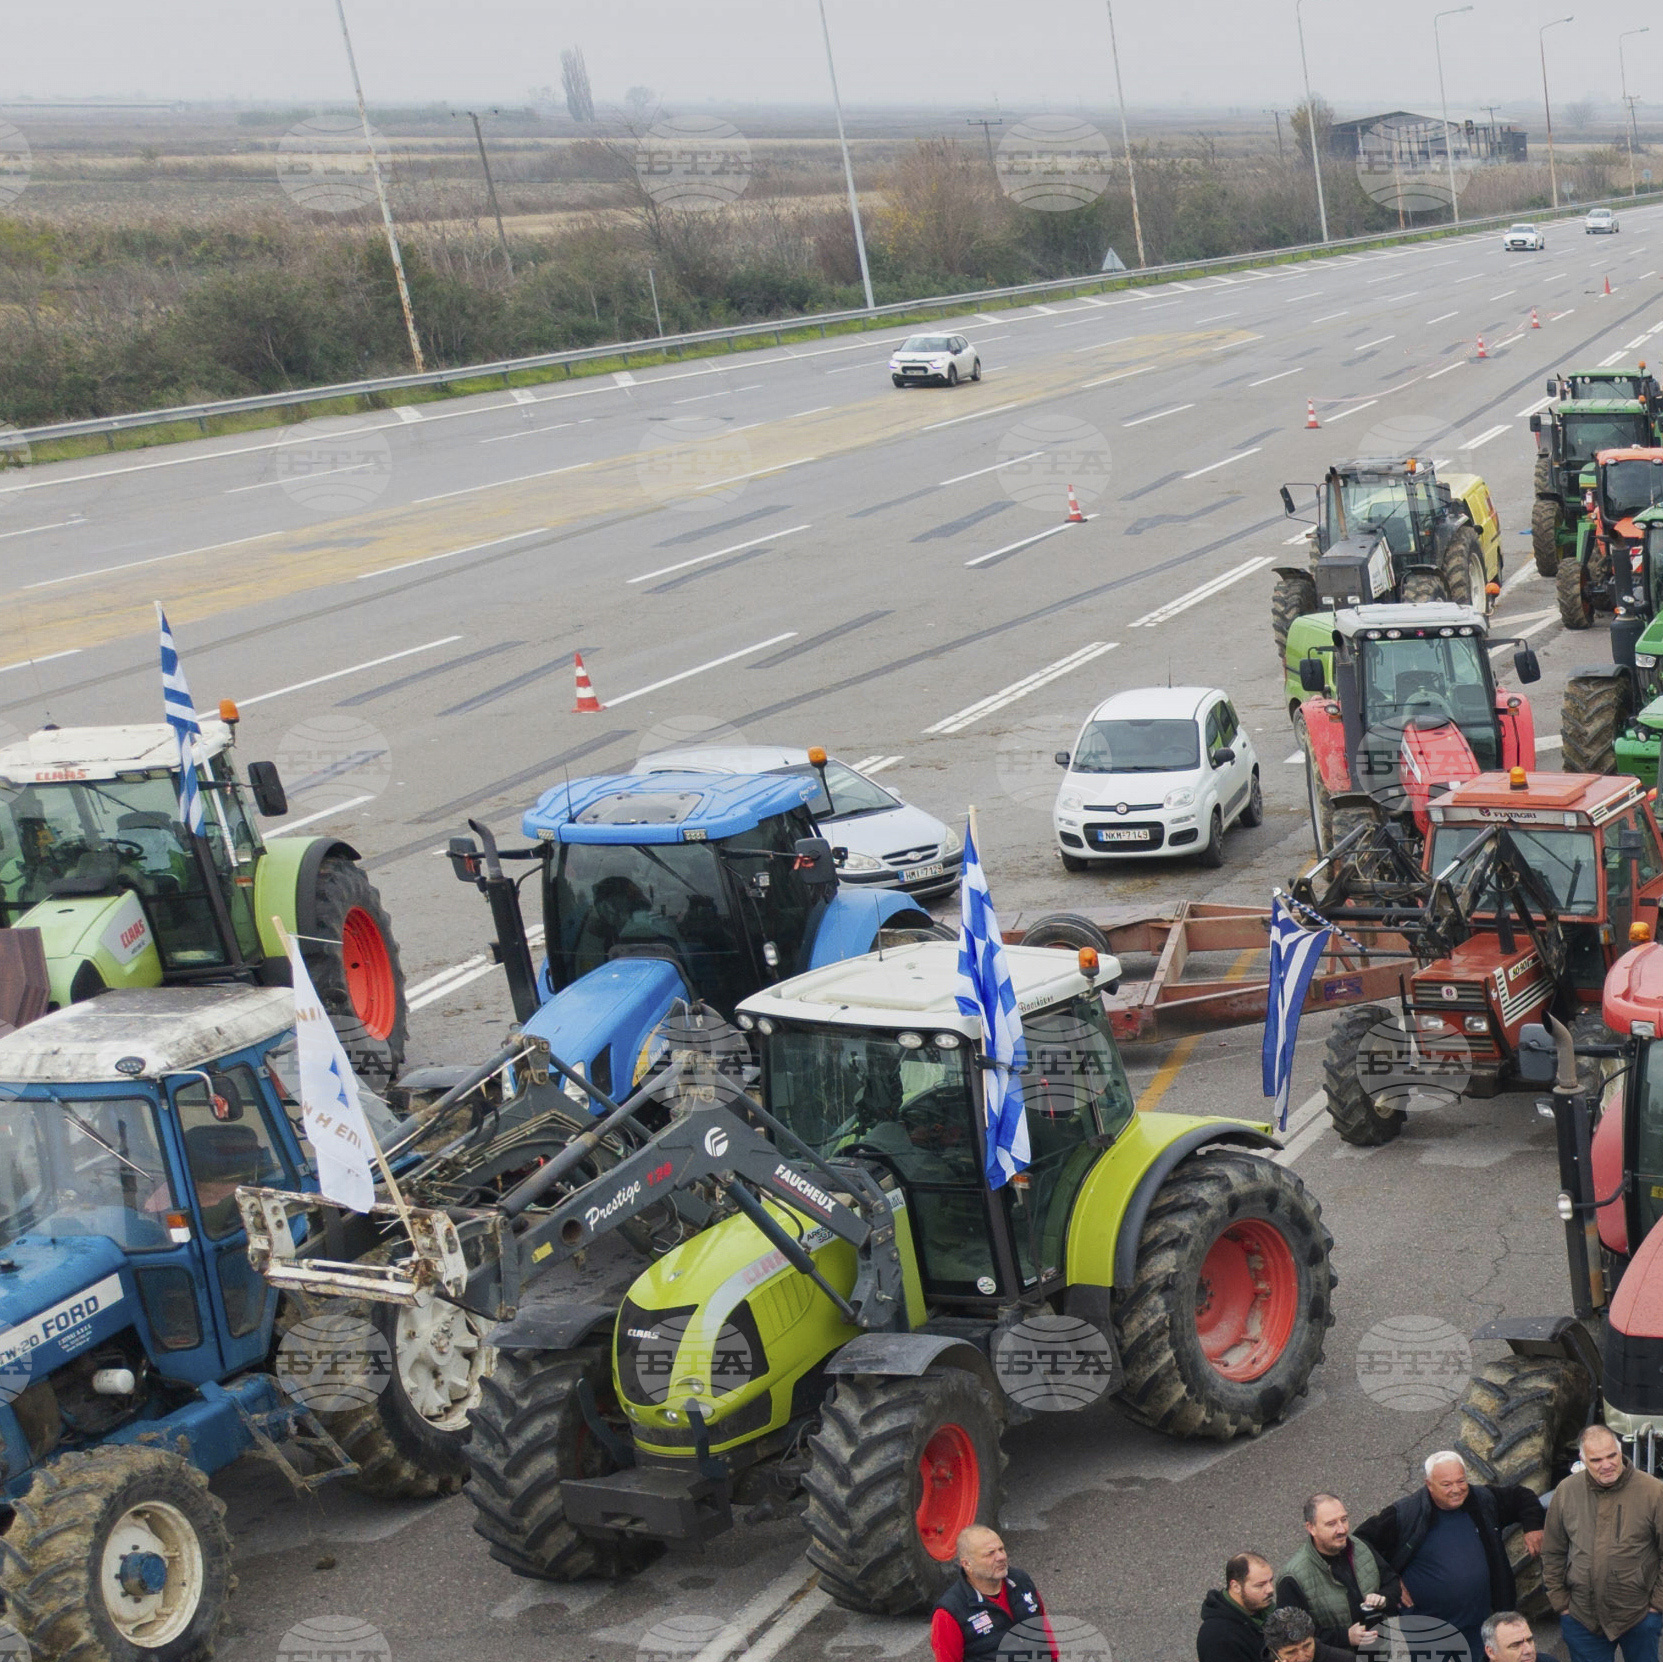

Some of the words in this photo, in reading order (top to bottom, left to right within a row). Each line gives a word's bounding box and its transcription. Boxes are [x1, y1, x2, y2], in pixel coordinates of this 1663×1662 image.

[35, 770, 87, 781] CLAAS
[1493, 811, 1537, 820] FIATAGRI
[120, 918, 147, 949] CLAAS
[774, 1163, 838, 1215] FAUCHEUX
[585, 1180, 643, 1233] Prestige
[742, 1250, 788, 1285] CLAA
[42, 1294, 100, 1340] FORD
[627, 1328, 660, 1341] CLAAS
